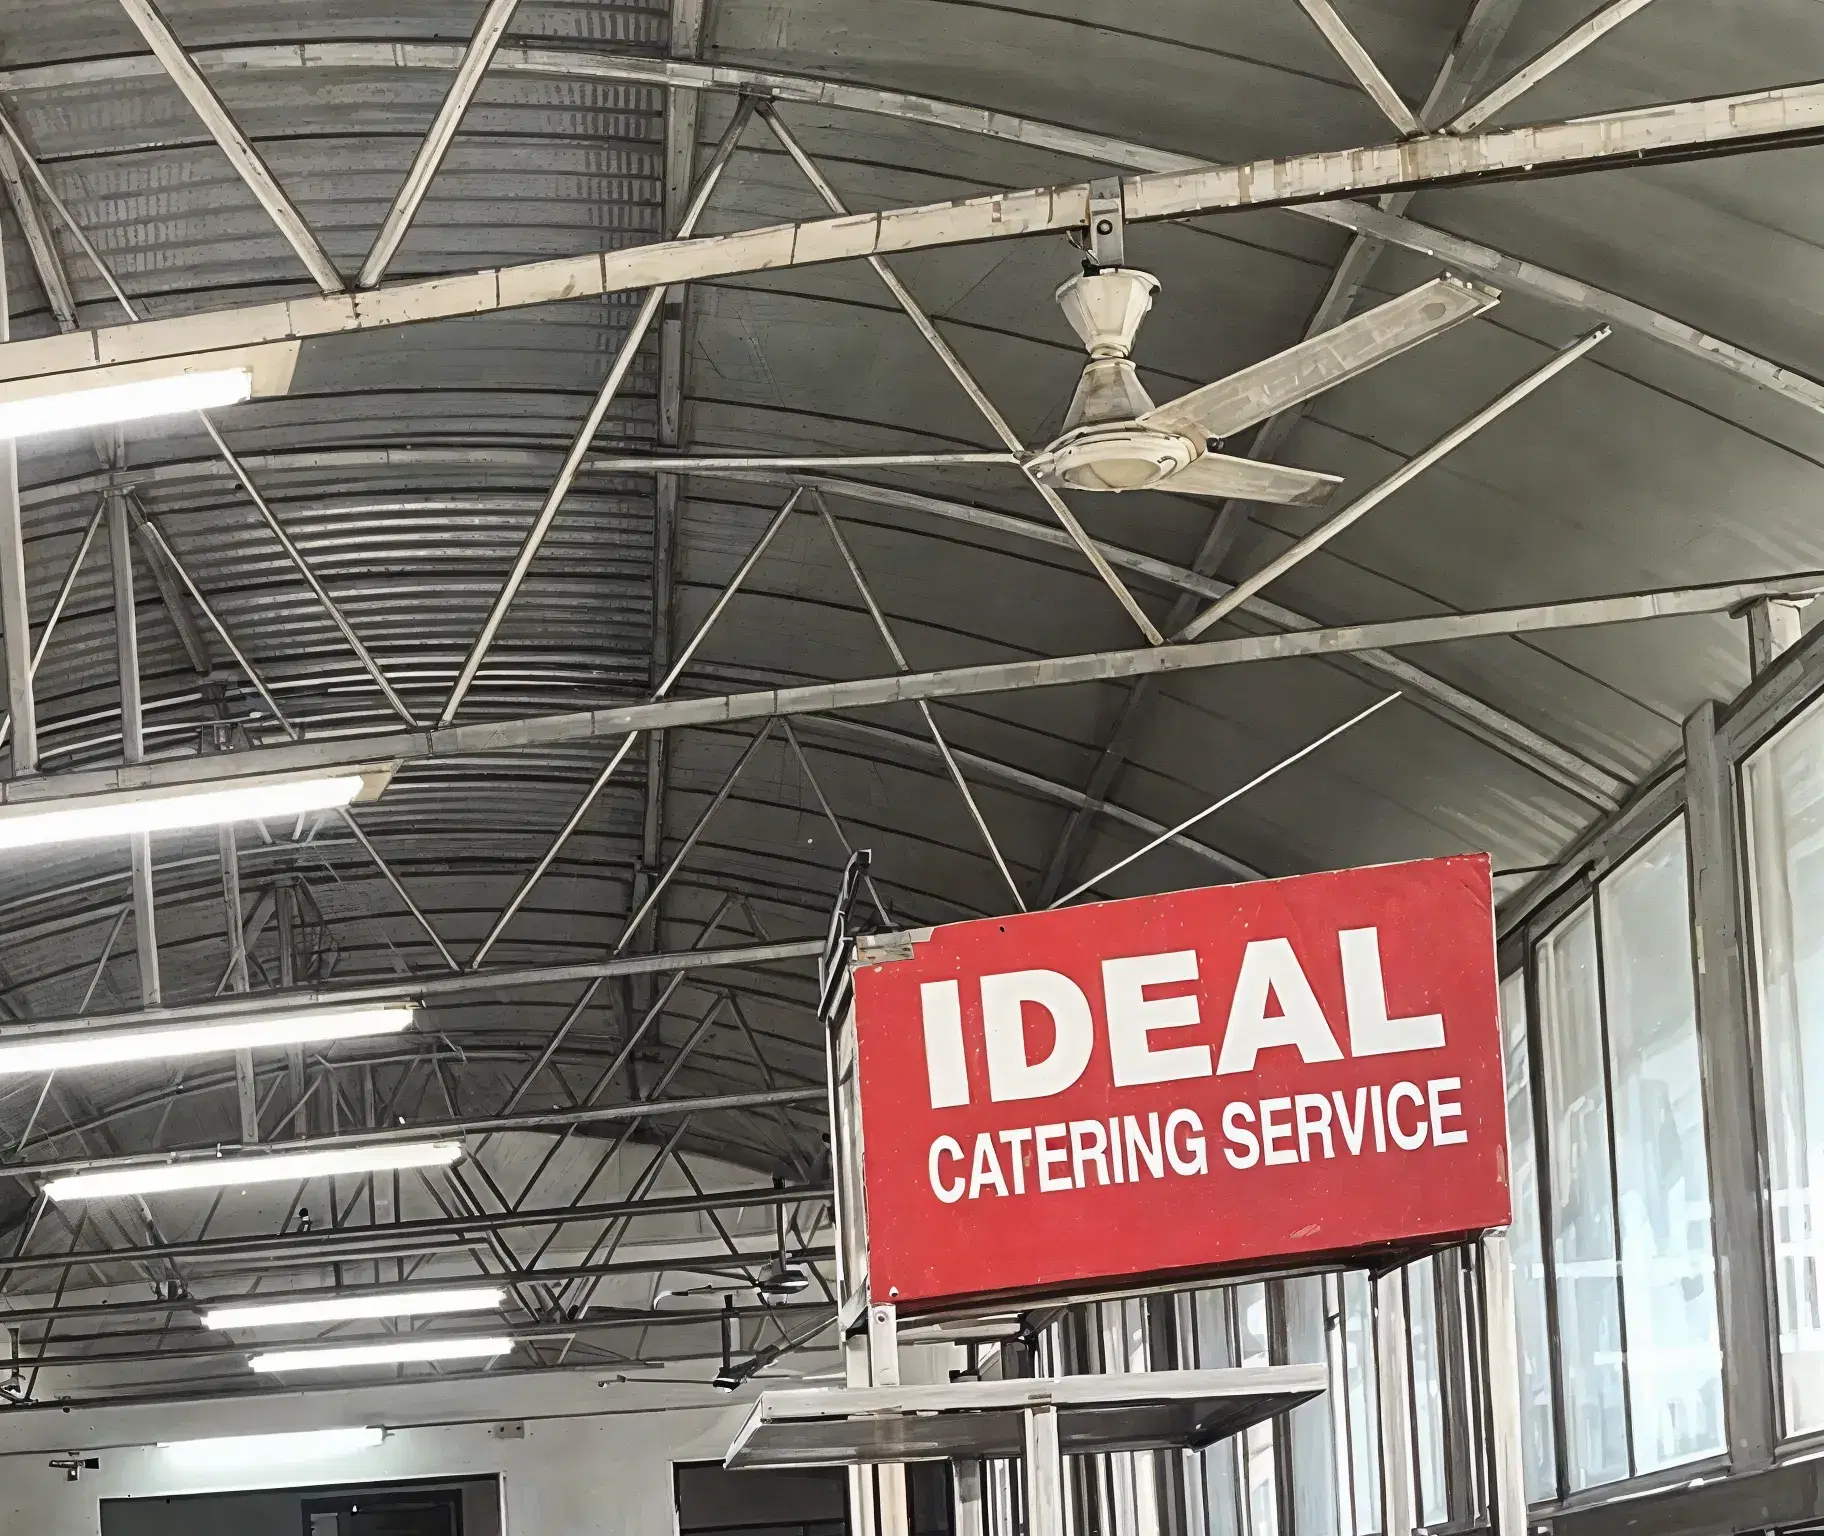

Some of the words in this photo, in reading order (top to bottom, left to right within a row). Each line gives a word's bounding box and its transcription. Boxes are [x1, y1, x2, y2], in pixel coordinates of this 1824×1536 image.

[919, 926, 1446, 1110] IDEAL
[927, 1106, 1208, 1205] CATERING
[1221, 1075, 1468, 1170] SERVICE
